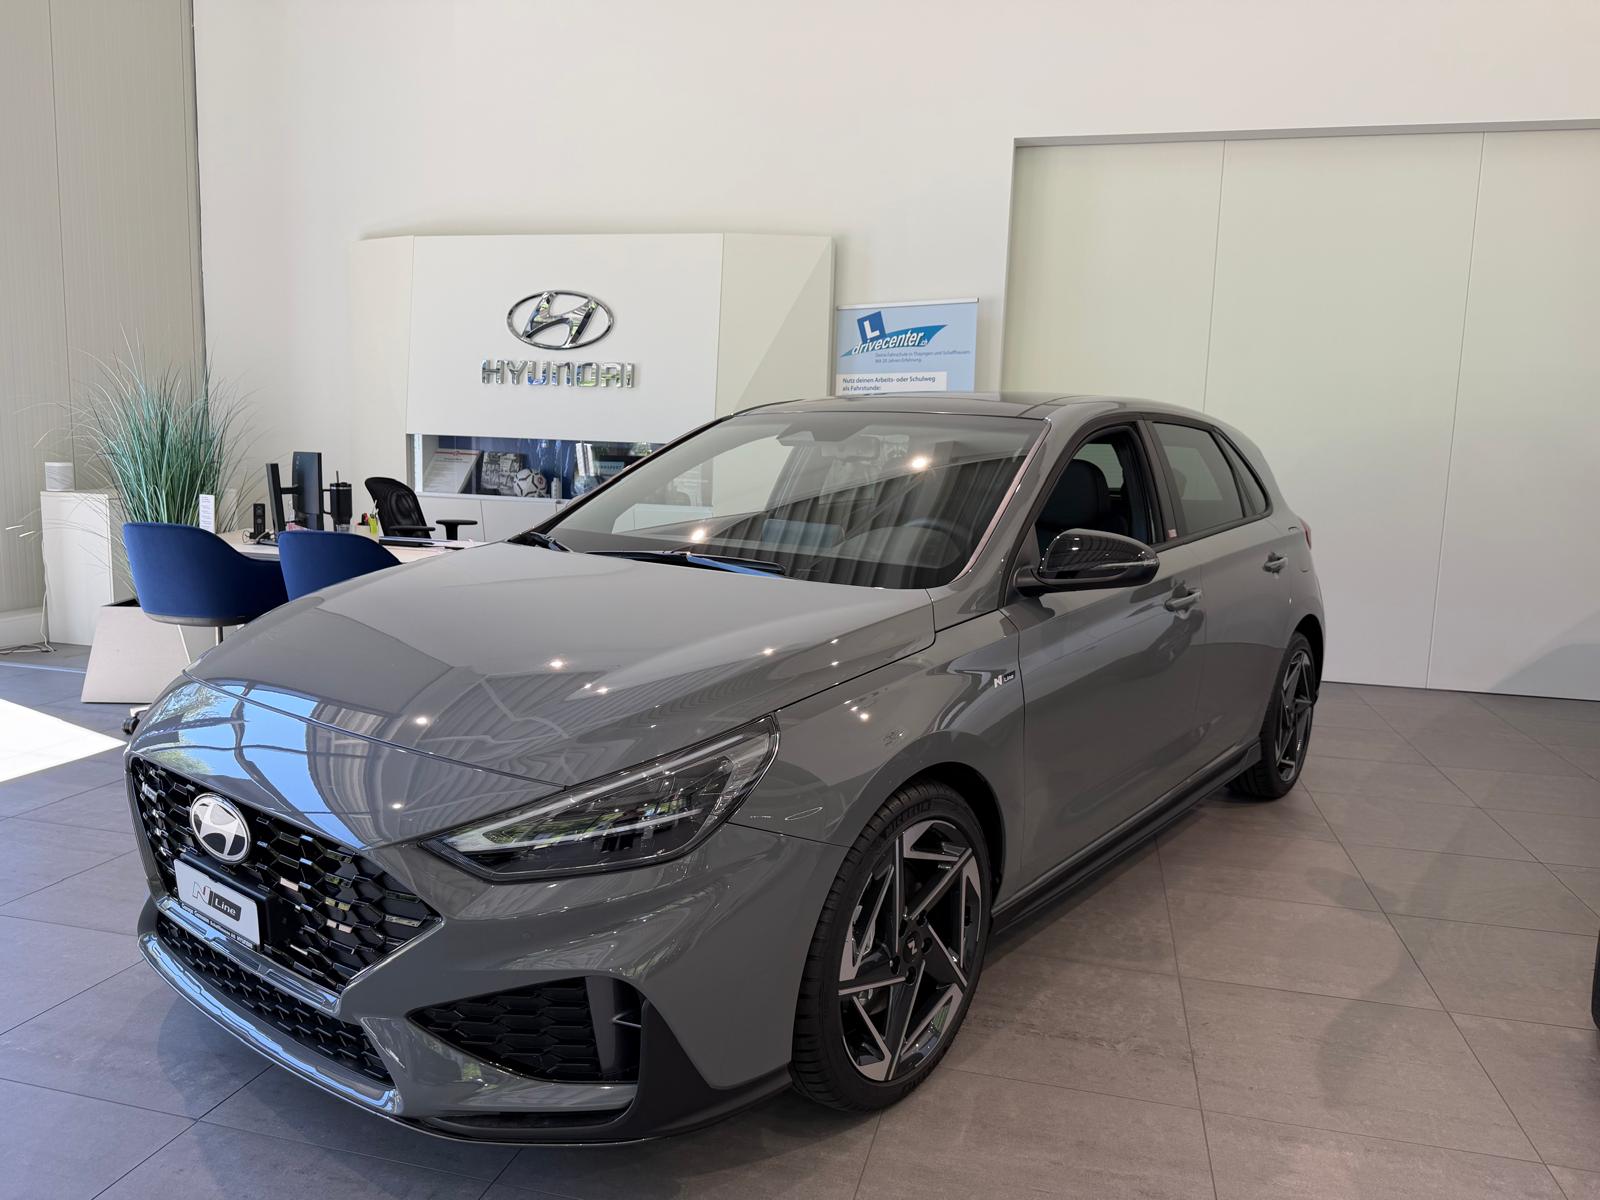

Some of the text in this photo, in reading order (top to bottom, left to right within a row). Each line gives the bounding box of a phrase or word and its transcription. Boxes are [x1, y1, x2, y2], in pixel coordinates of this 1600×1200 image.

[863, 320, 880, 339] L
[481, 359, 636, 389] HYUNDAI
[214, 898, 237, 917] Line
